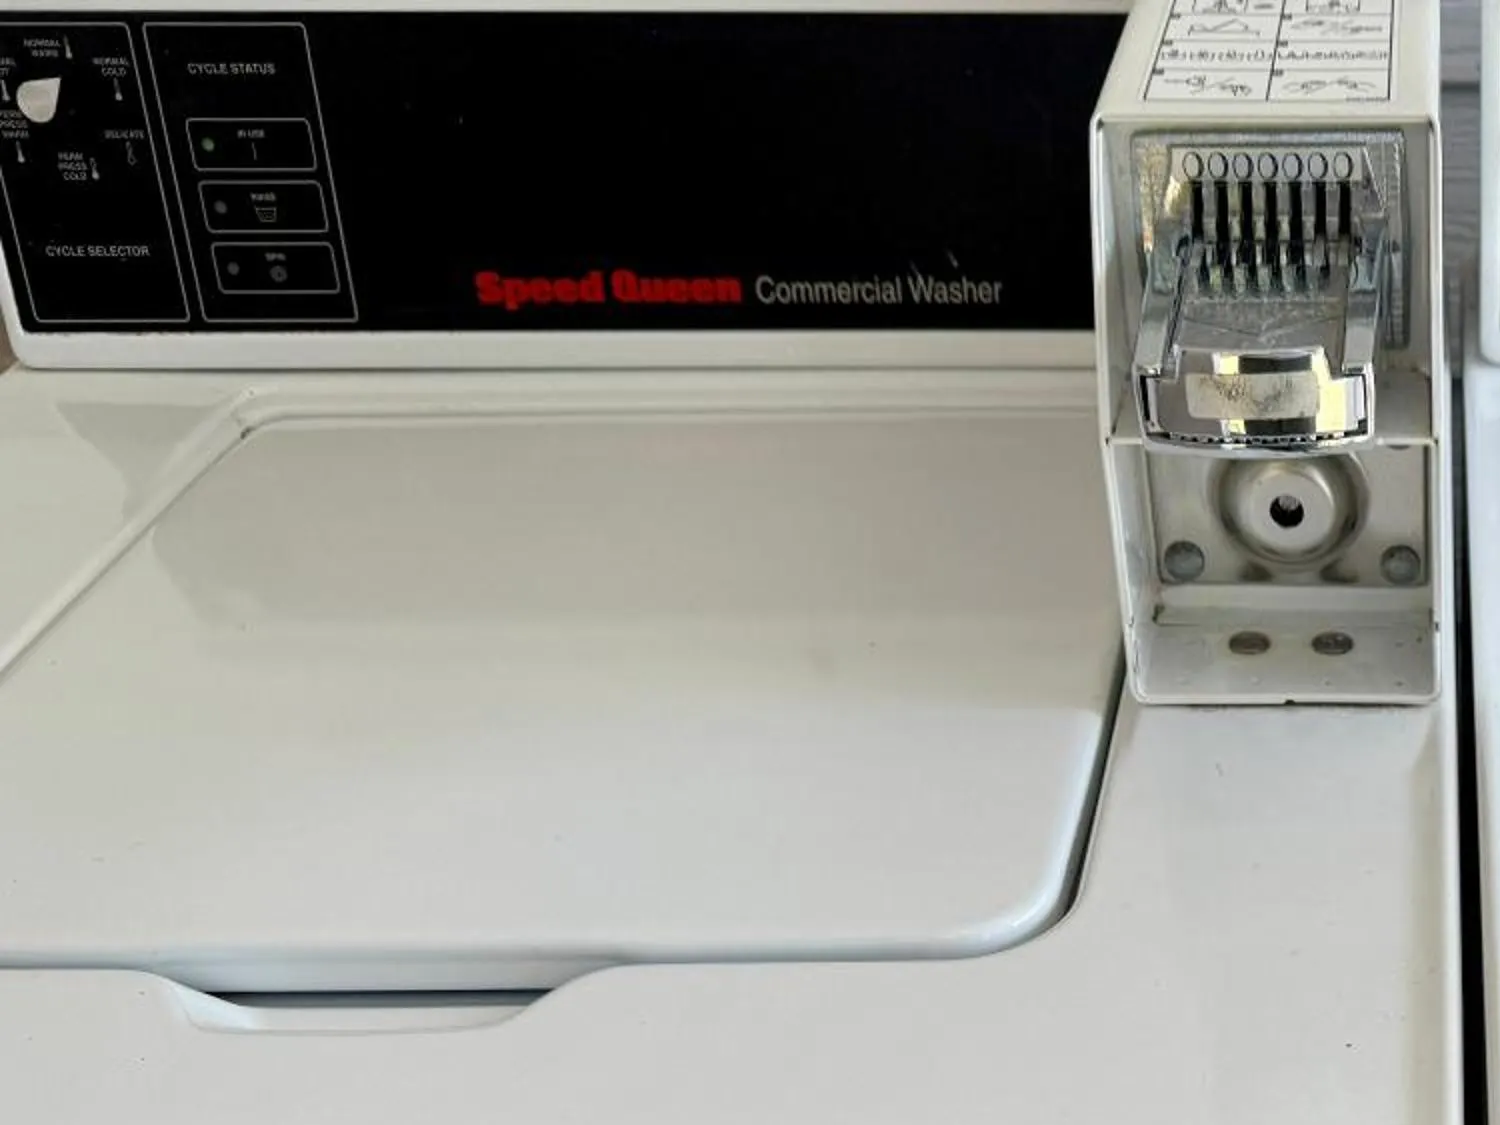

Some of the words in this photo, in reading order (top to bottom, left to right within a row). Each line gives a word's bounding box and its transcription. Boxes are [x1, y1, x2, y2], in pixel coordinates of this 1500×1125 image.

[187, 63, 228, 74] CYCLE
[229, 63, 276, 75] STATUS
[45, 245, 86, 256] CYCLE
[87, 245, 150, 257] SELECTOR
[474, 270, 606, 310] Speed
[610, 269, 742, 304] Queen
[754, 275, 902, 304] Commercial
[906, 276, 1003, 304] Washer
